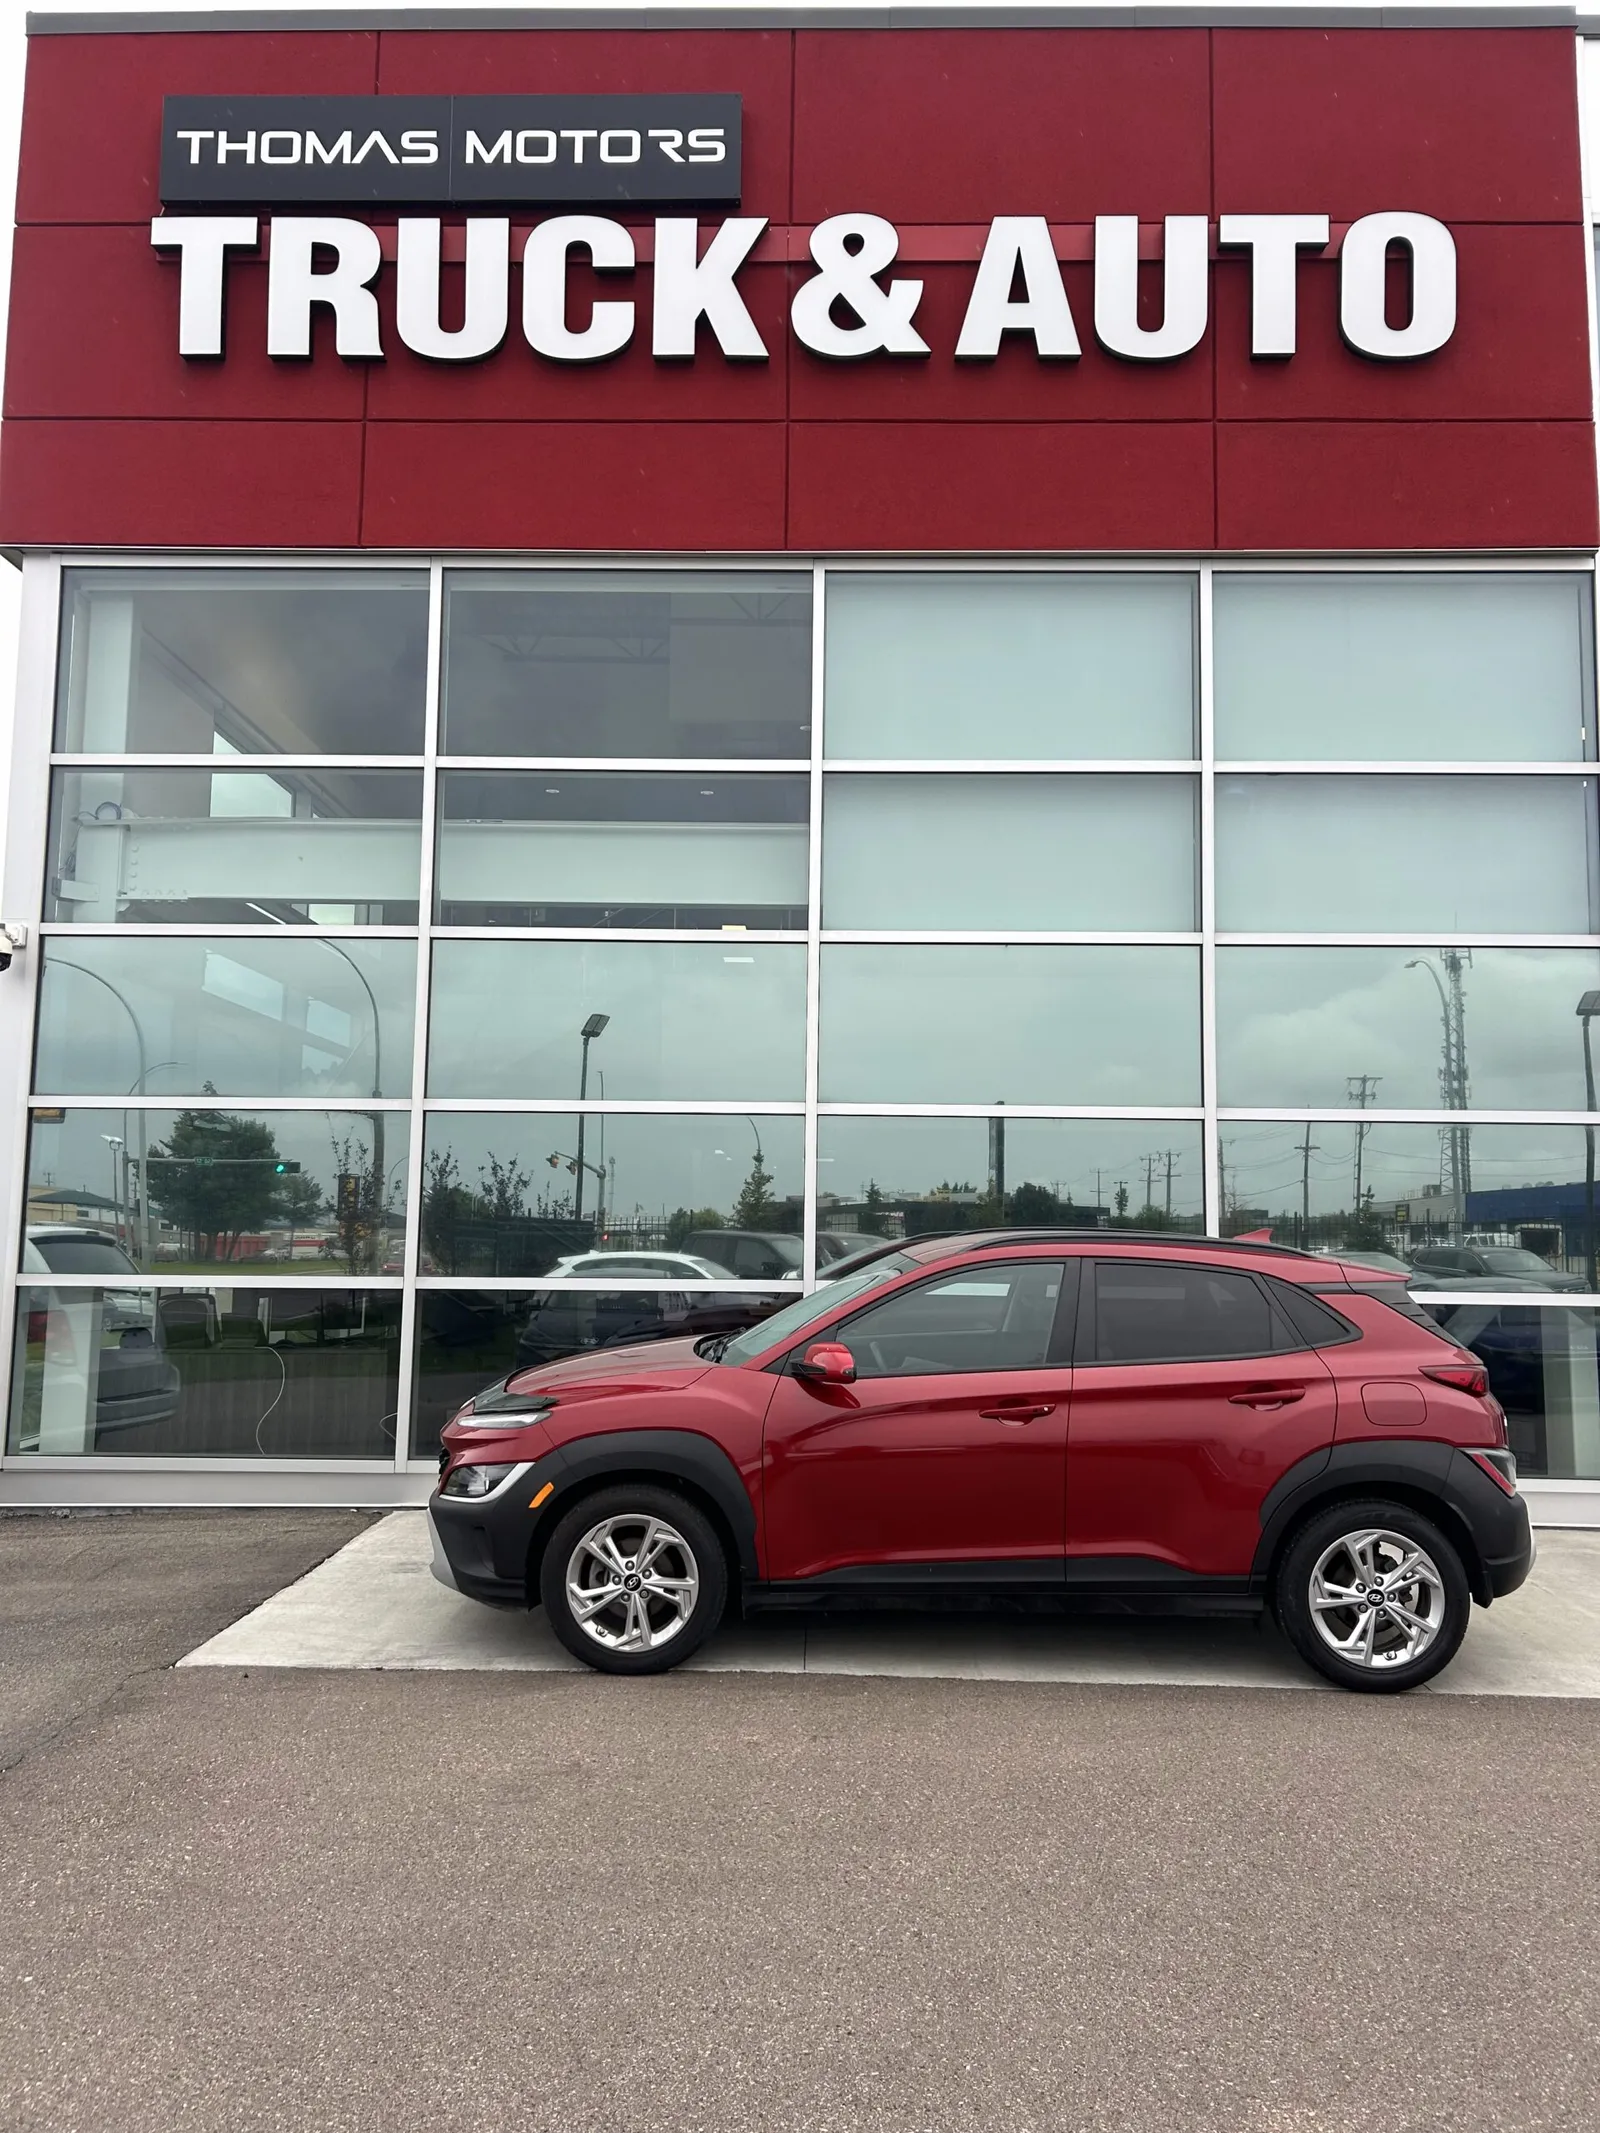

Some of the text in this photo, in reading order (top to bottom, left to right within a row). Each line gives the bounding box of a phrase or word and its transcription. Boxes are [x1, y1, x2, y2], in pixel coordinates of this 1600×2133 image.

[176, 128, 726, 165] THOMAS MOTORS
[150, 211, 1458, 360] TRUCK & AUTO
